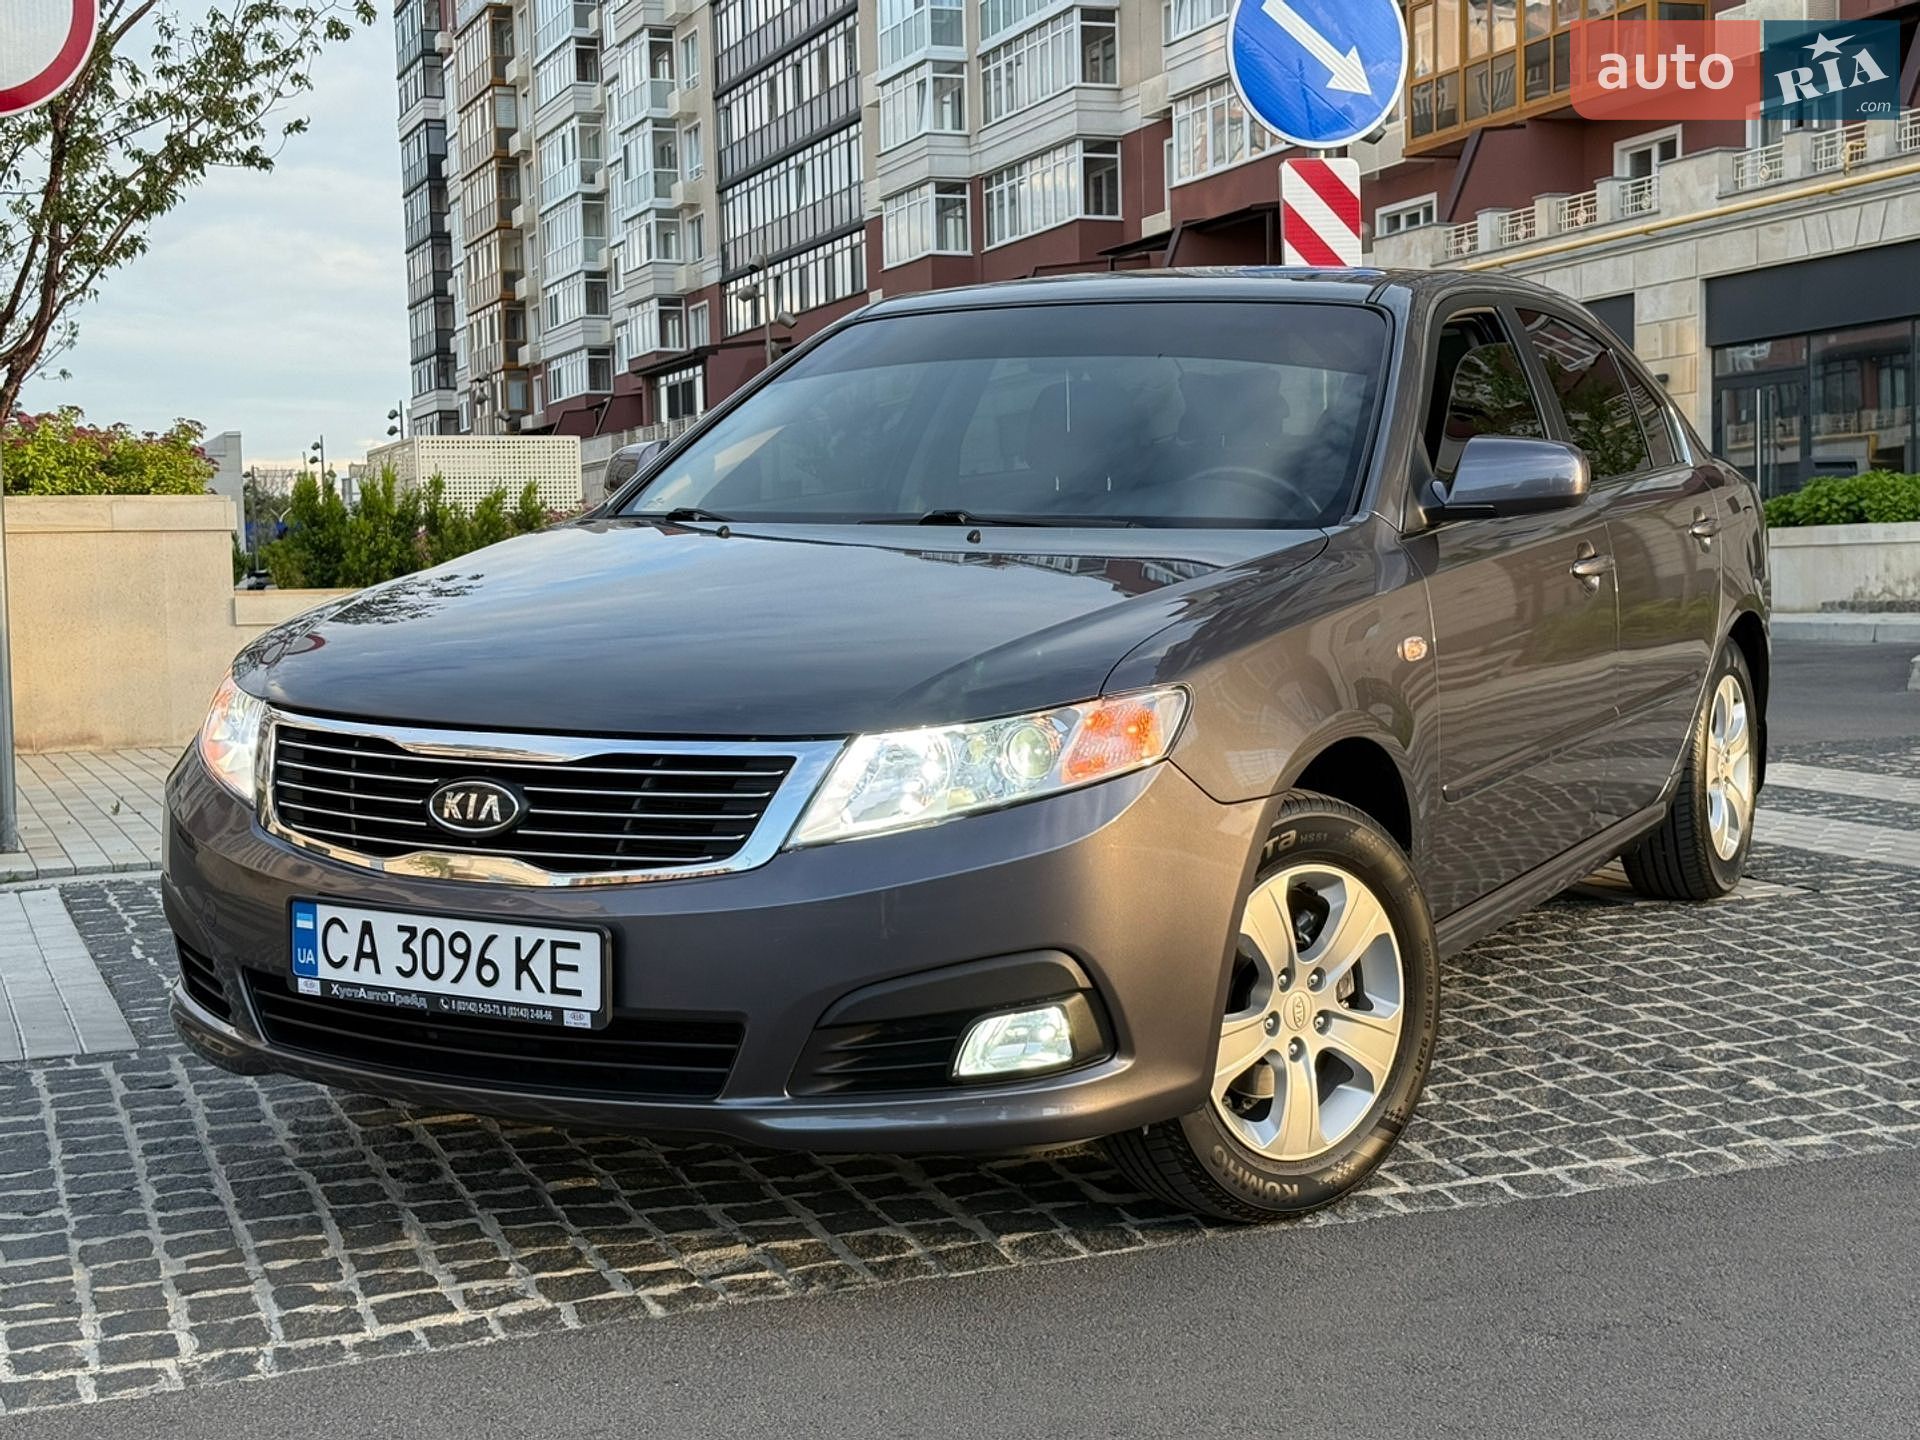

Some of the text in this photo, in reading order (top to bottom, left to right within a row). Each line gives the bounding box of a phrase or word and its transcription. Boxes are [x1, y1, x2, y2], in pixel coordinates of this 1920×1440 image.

[443, 791, 501, 822] KIA
[297, 948, 315, 965] UA
[321, 916, 583, 998] CA 3096 KE
[1208, 1144, 1299, 1199] KUMHO
